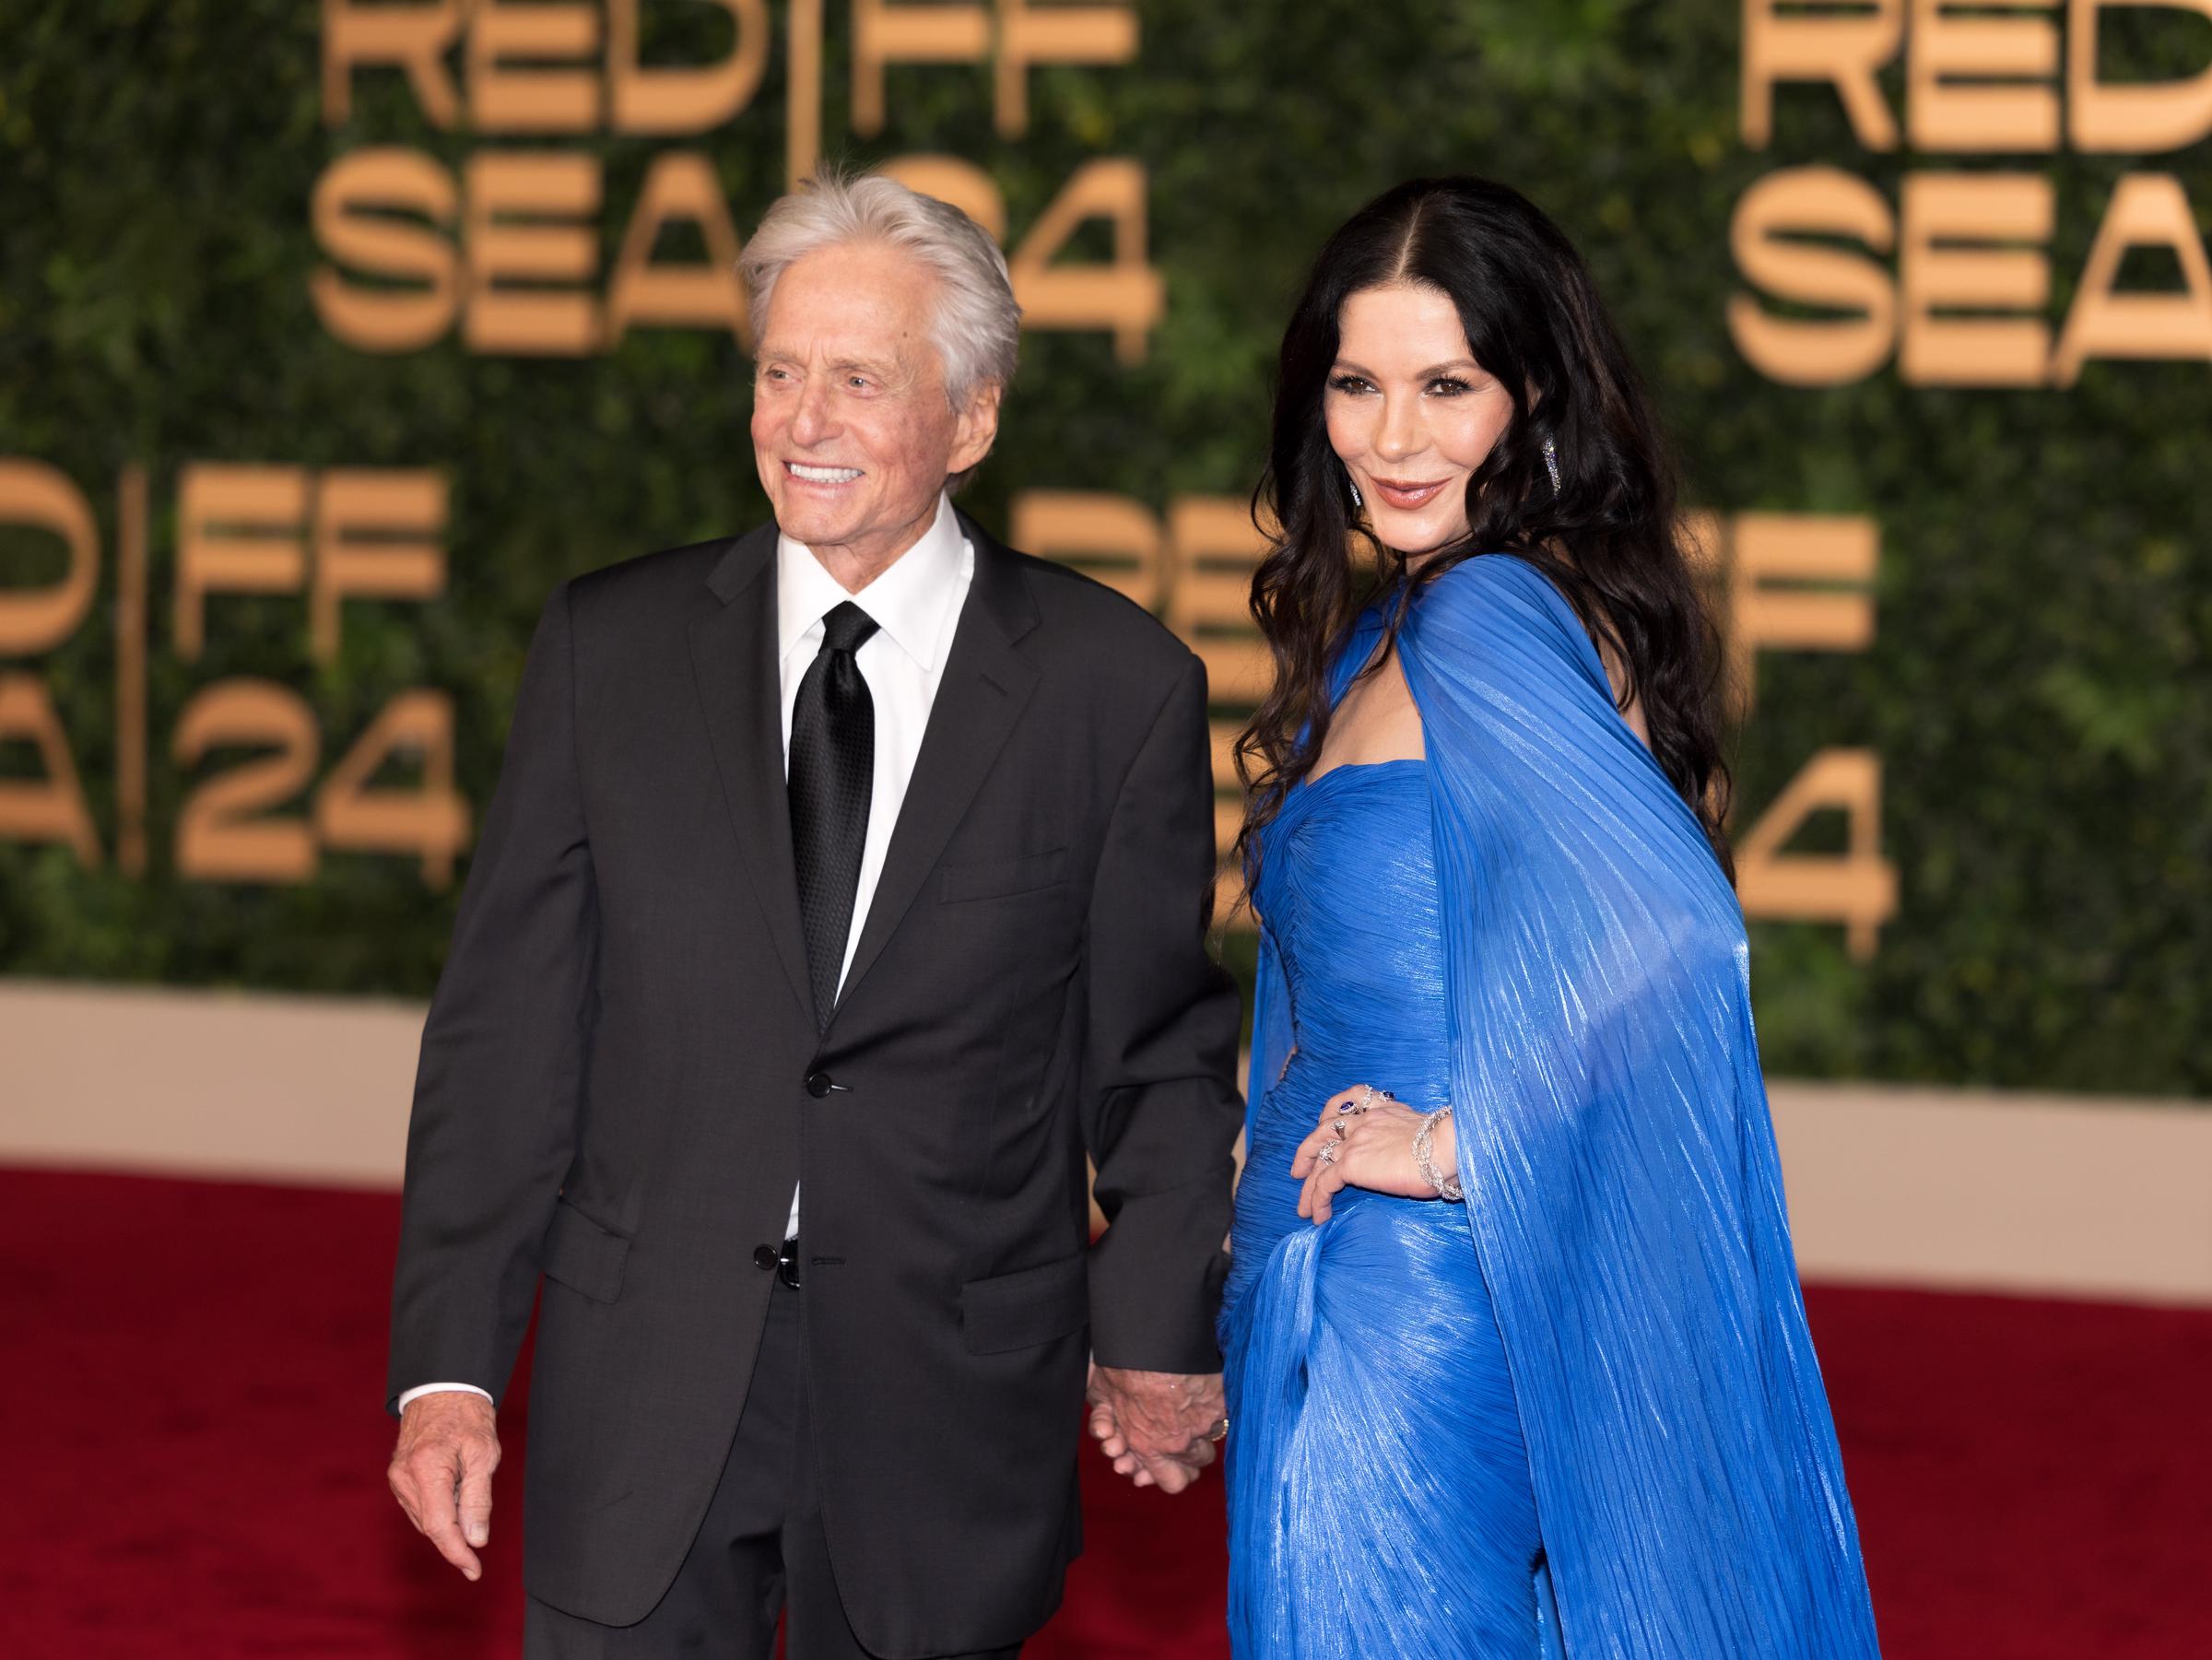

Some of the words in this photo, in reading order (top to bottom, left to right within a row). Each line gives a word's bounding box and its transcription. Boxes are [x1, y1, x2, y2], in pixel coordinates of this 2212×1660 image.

[322, 0, 768, 135] RED
[1740, 0, 2212, 154] RED
[310, 146, 754, 358] SEA
[1726, 166, 2212, 391] SEA
[174, 464, 450, 667] FF
[172, 677, 472, 894] 24
